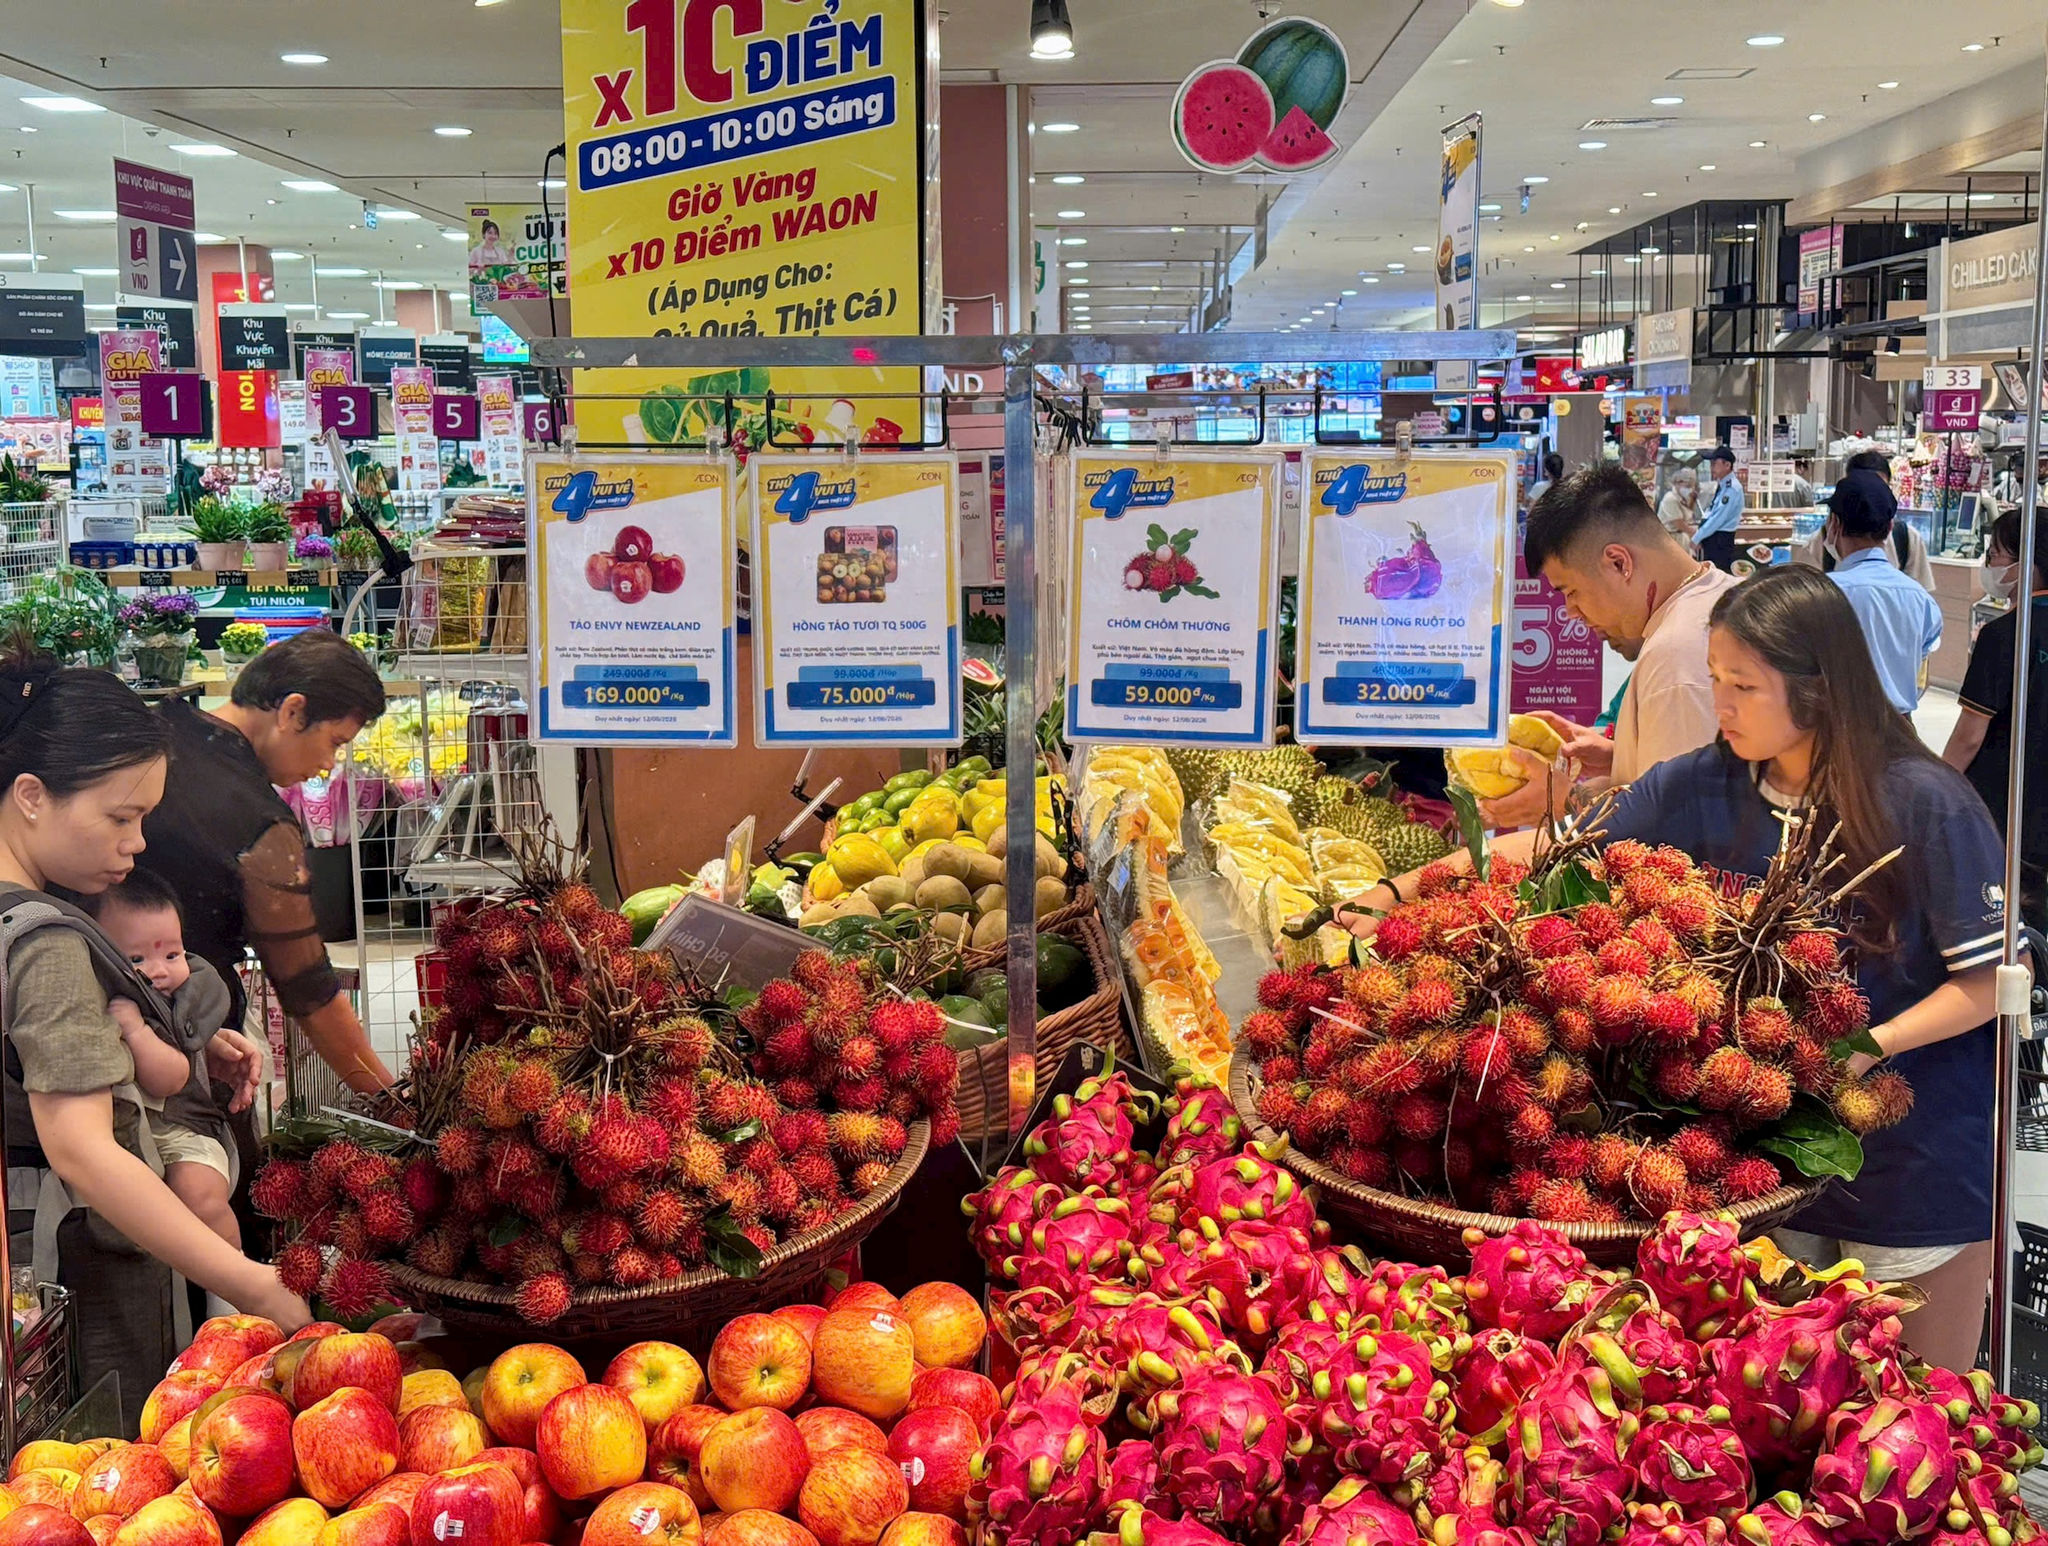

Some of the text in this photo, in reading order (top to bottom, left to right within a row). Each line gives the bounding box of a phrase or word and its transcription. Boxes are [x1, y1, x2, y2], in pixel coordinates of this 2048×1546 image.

[745, 0, 882, 95] ĐIỂM
[590, 131, 686, 177] 08:00
[708, 106, 796, 151] 10:00
[803, 92, 884, 130] Sáng
[668, 167, 817, 222] Giờ Vàng
[605, 190, 878, 280] x10 Điểm WAON
[1951, 255, 2006, 289] CHILLED
[131, 273, 148, 290] VND
[648, 262, 833, 316] (Áp Dụng Cho:
[119, 294, 126, 305] 4
[143, 309, 166, 321] Khu
[221, 305, 228, 315] 5
[774, 297, 835, 337] Thịt
[843, 287, 898, 320] Cá)
[243, 318, 264, 329] Khu
[296, 322, 302, 332] 6
[244, 331, 265, 342] Vực
[315, 334, 334, 344] Khu
[363, 328, 368, 336] 7
[106, 346, 154, 371] GIÁ
[246, 358, 266, 369] Mãi
[310, 366, 347, 385] GIÁ
[1946, 370, 1971, 386] 33
[397, 382, 429, 397] GIÁ
[163, 385, 179, 421] 1
[484, 391, 508, 405] GIÁ
[337, 396, 356, 427] 3
[446, 403, 463, 429] 5
[534, 409, 550, 432] 6
[1946, 418, 1968, 427] VND
[546, 471, 633, 521] THỨ 4 VUI VẺ
[1085, 468, 1173, 518] THỨ 4 VUI VẺ
[1316, 464, 1405, 515] THỨ 4 VUI VẺ
[768, 472, 855, 522] THỨ 4 VUI VẺ
[250, 595, 305, 606] TÚI NILON
[570, 619, 701, 630] TÁO ENVY NEWZEALAND
[793, 619, 927, 631] HỒNG TÁO TƯƠI TQ 500G
[1107, 618, 1230, 632] CHÔM CHÔM THƯỜNG
[1338, 615, 1465, 628] THANH LONG RUỘT ĐỎ
[1557, 648, 1588, 657] KHÔNG
[1556, 657, 1595, 667] GIỚI HẠN
[1529, 685, 1572, 695] NGÀY HỘI
[1525, 695, 1577, 704] THÀNH VIÊN
